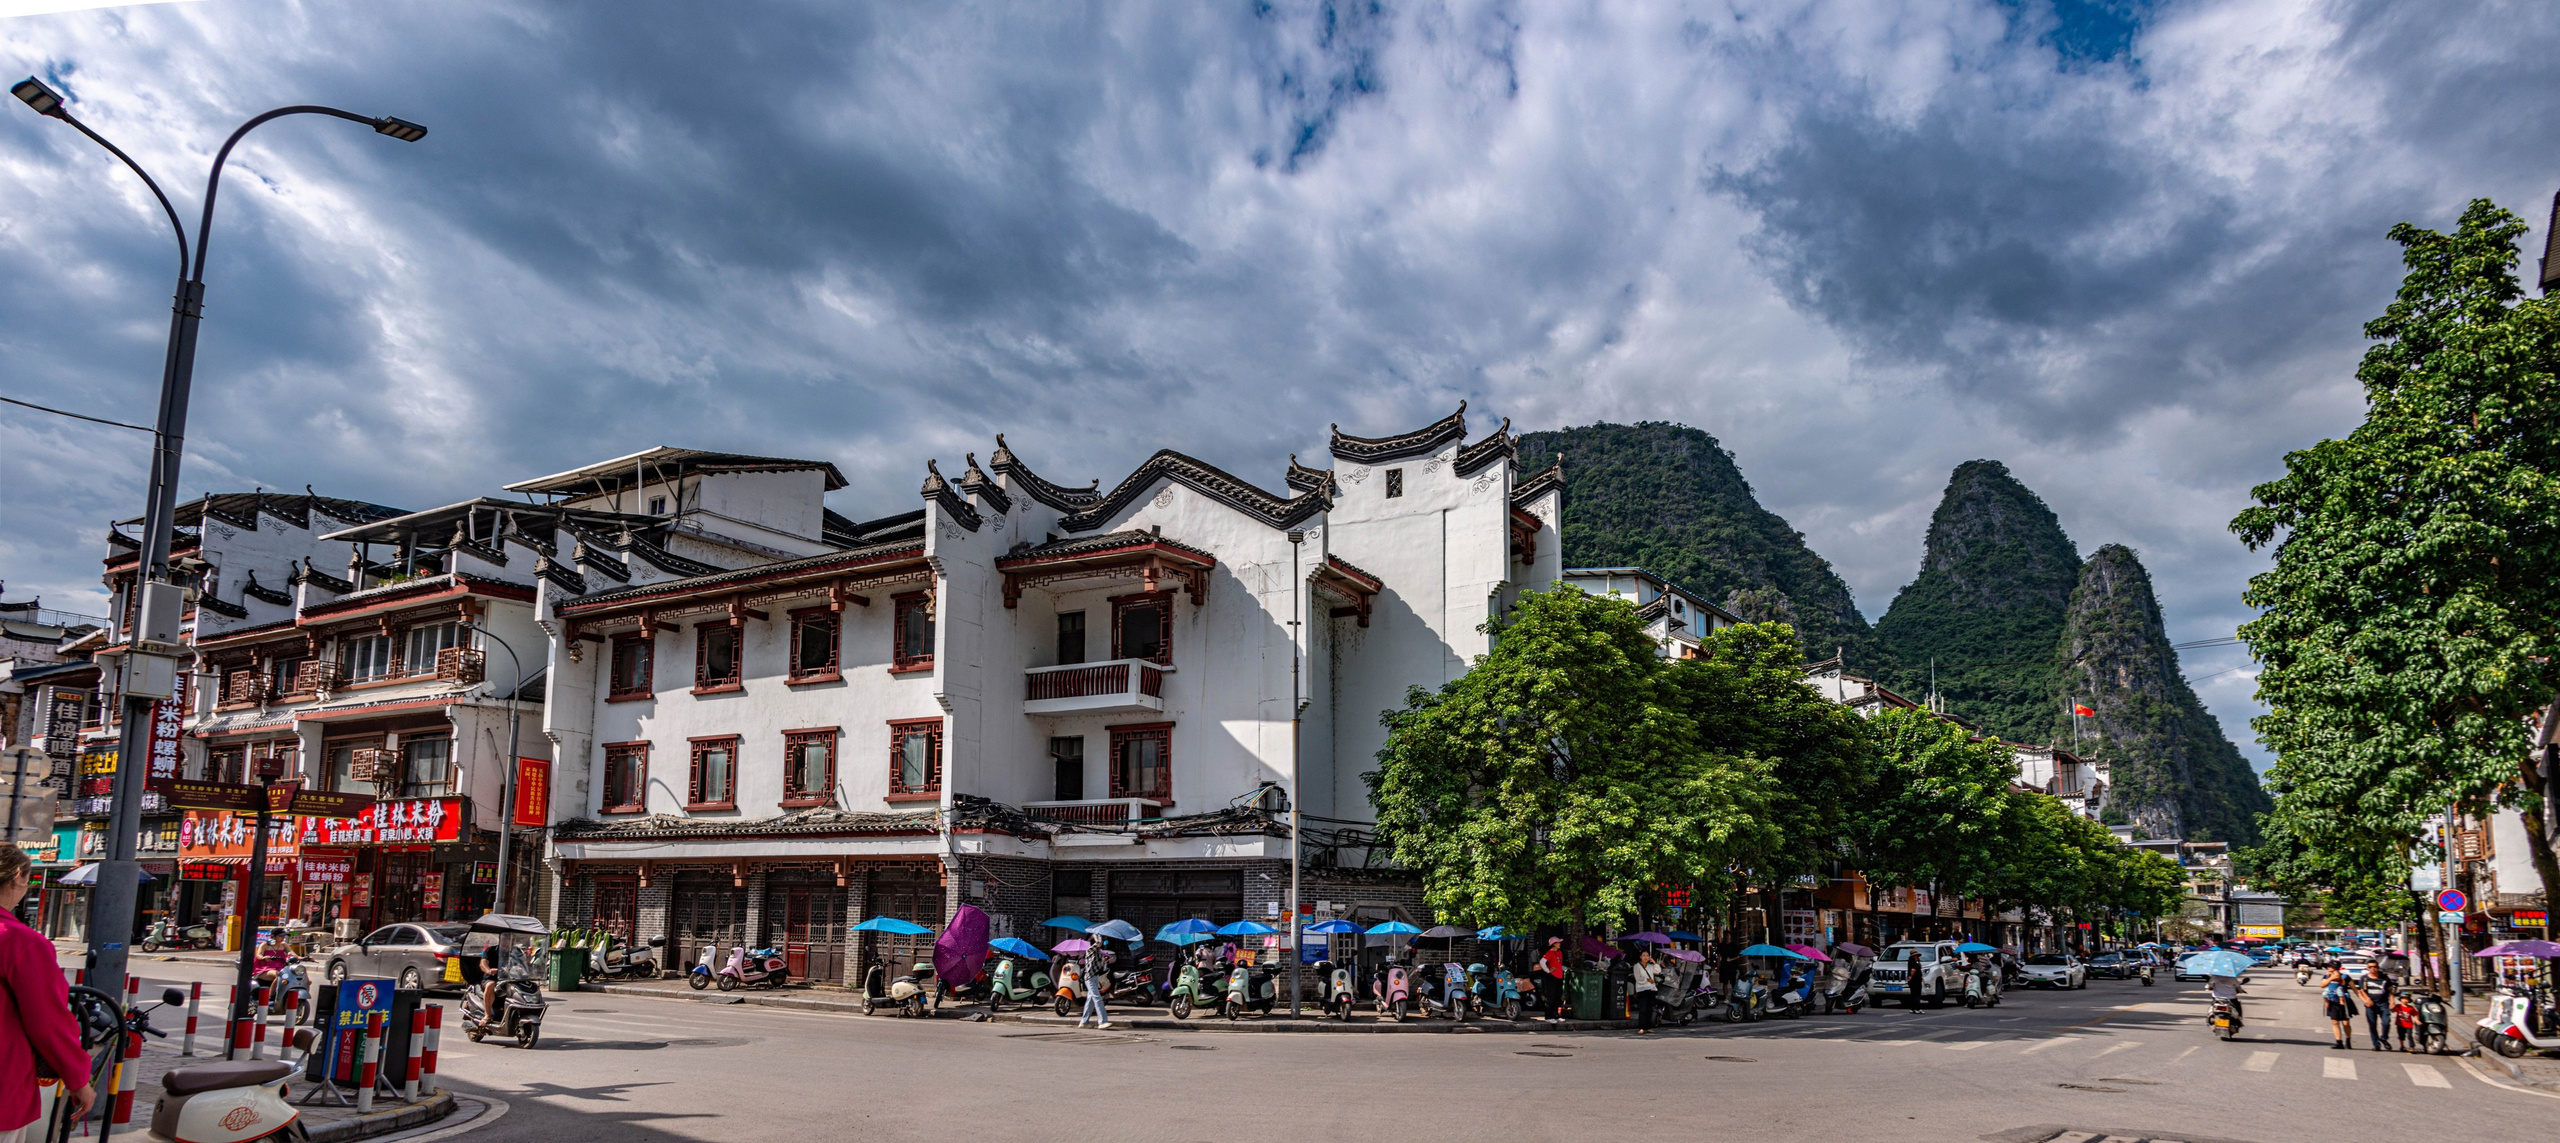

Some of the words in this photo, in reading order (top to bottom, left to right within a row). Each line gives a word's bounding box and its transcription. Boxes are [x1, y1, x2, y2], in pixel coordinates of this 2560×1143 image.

[50, 702, 79, 795] 佳鸿啤酒鱼
[174, 784, 221, 793] 观光车停车场
[296, 794, 344, 804] 汽车客运站
[304, 861, 350, 873] 桂林米粉
[309, 872, 344, 882] 螺蛳粉
